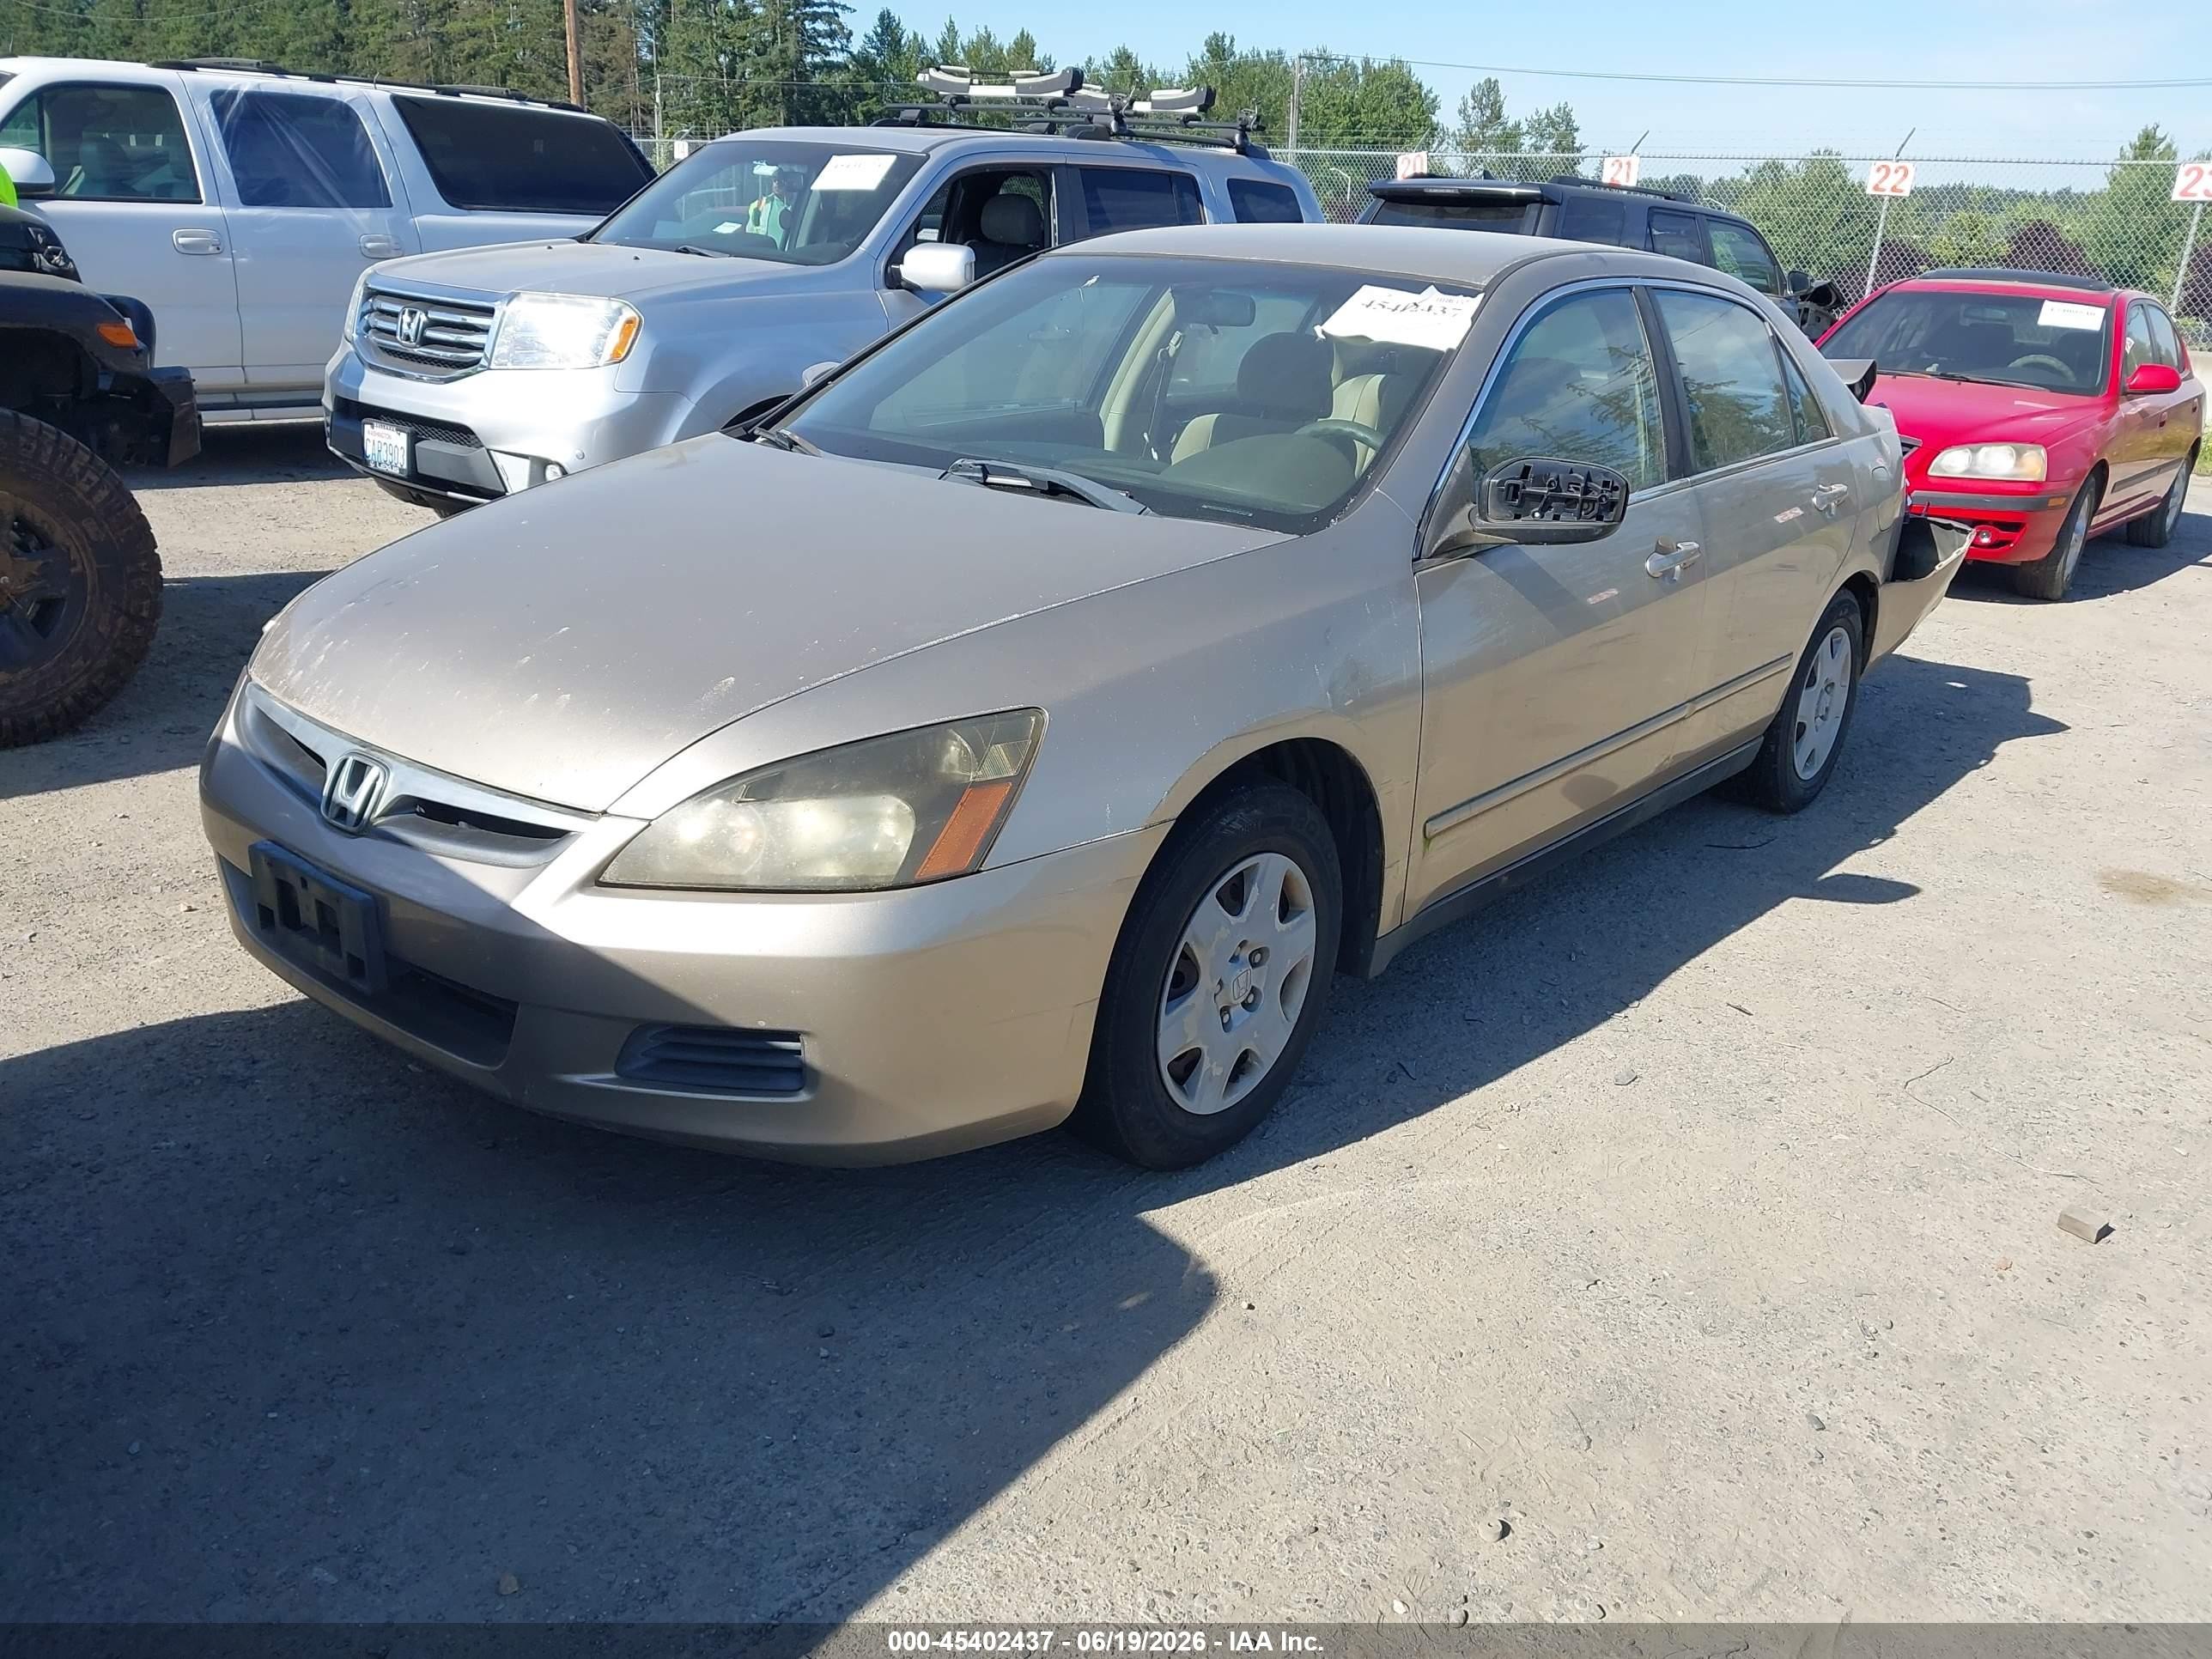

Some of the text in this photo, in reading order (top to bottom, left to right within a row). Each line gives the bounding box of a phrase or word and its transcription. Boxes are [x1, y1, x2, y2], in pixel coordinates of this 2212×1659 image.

[1401, 154, 1425, 179] 20
[1607, 159, 1632, 186] 21
[1872, 164, 1909, 193] 22
[365, 438, 405, 467] CAR3903
